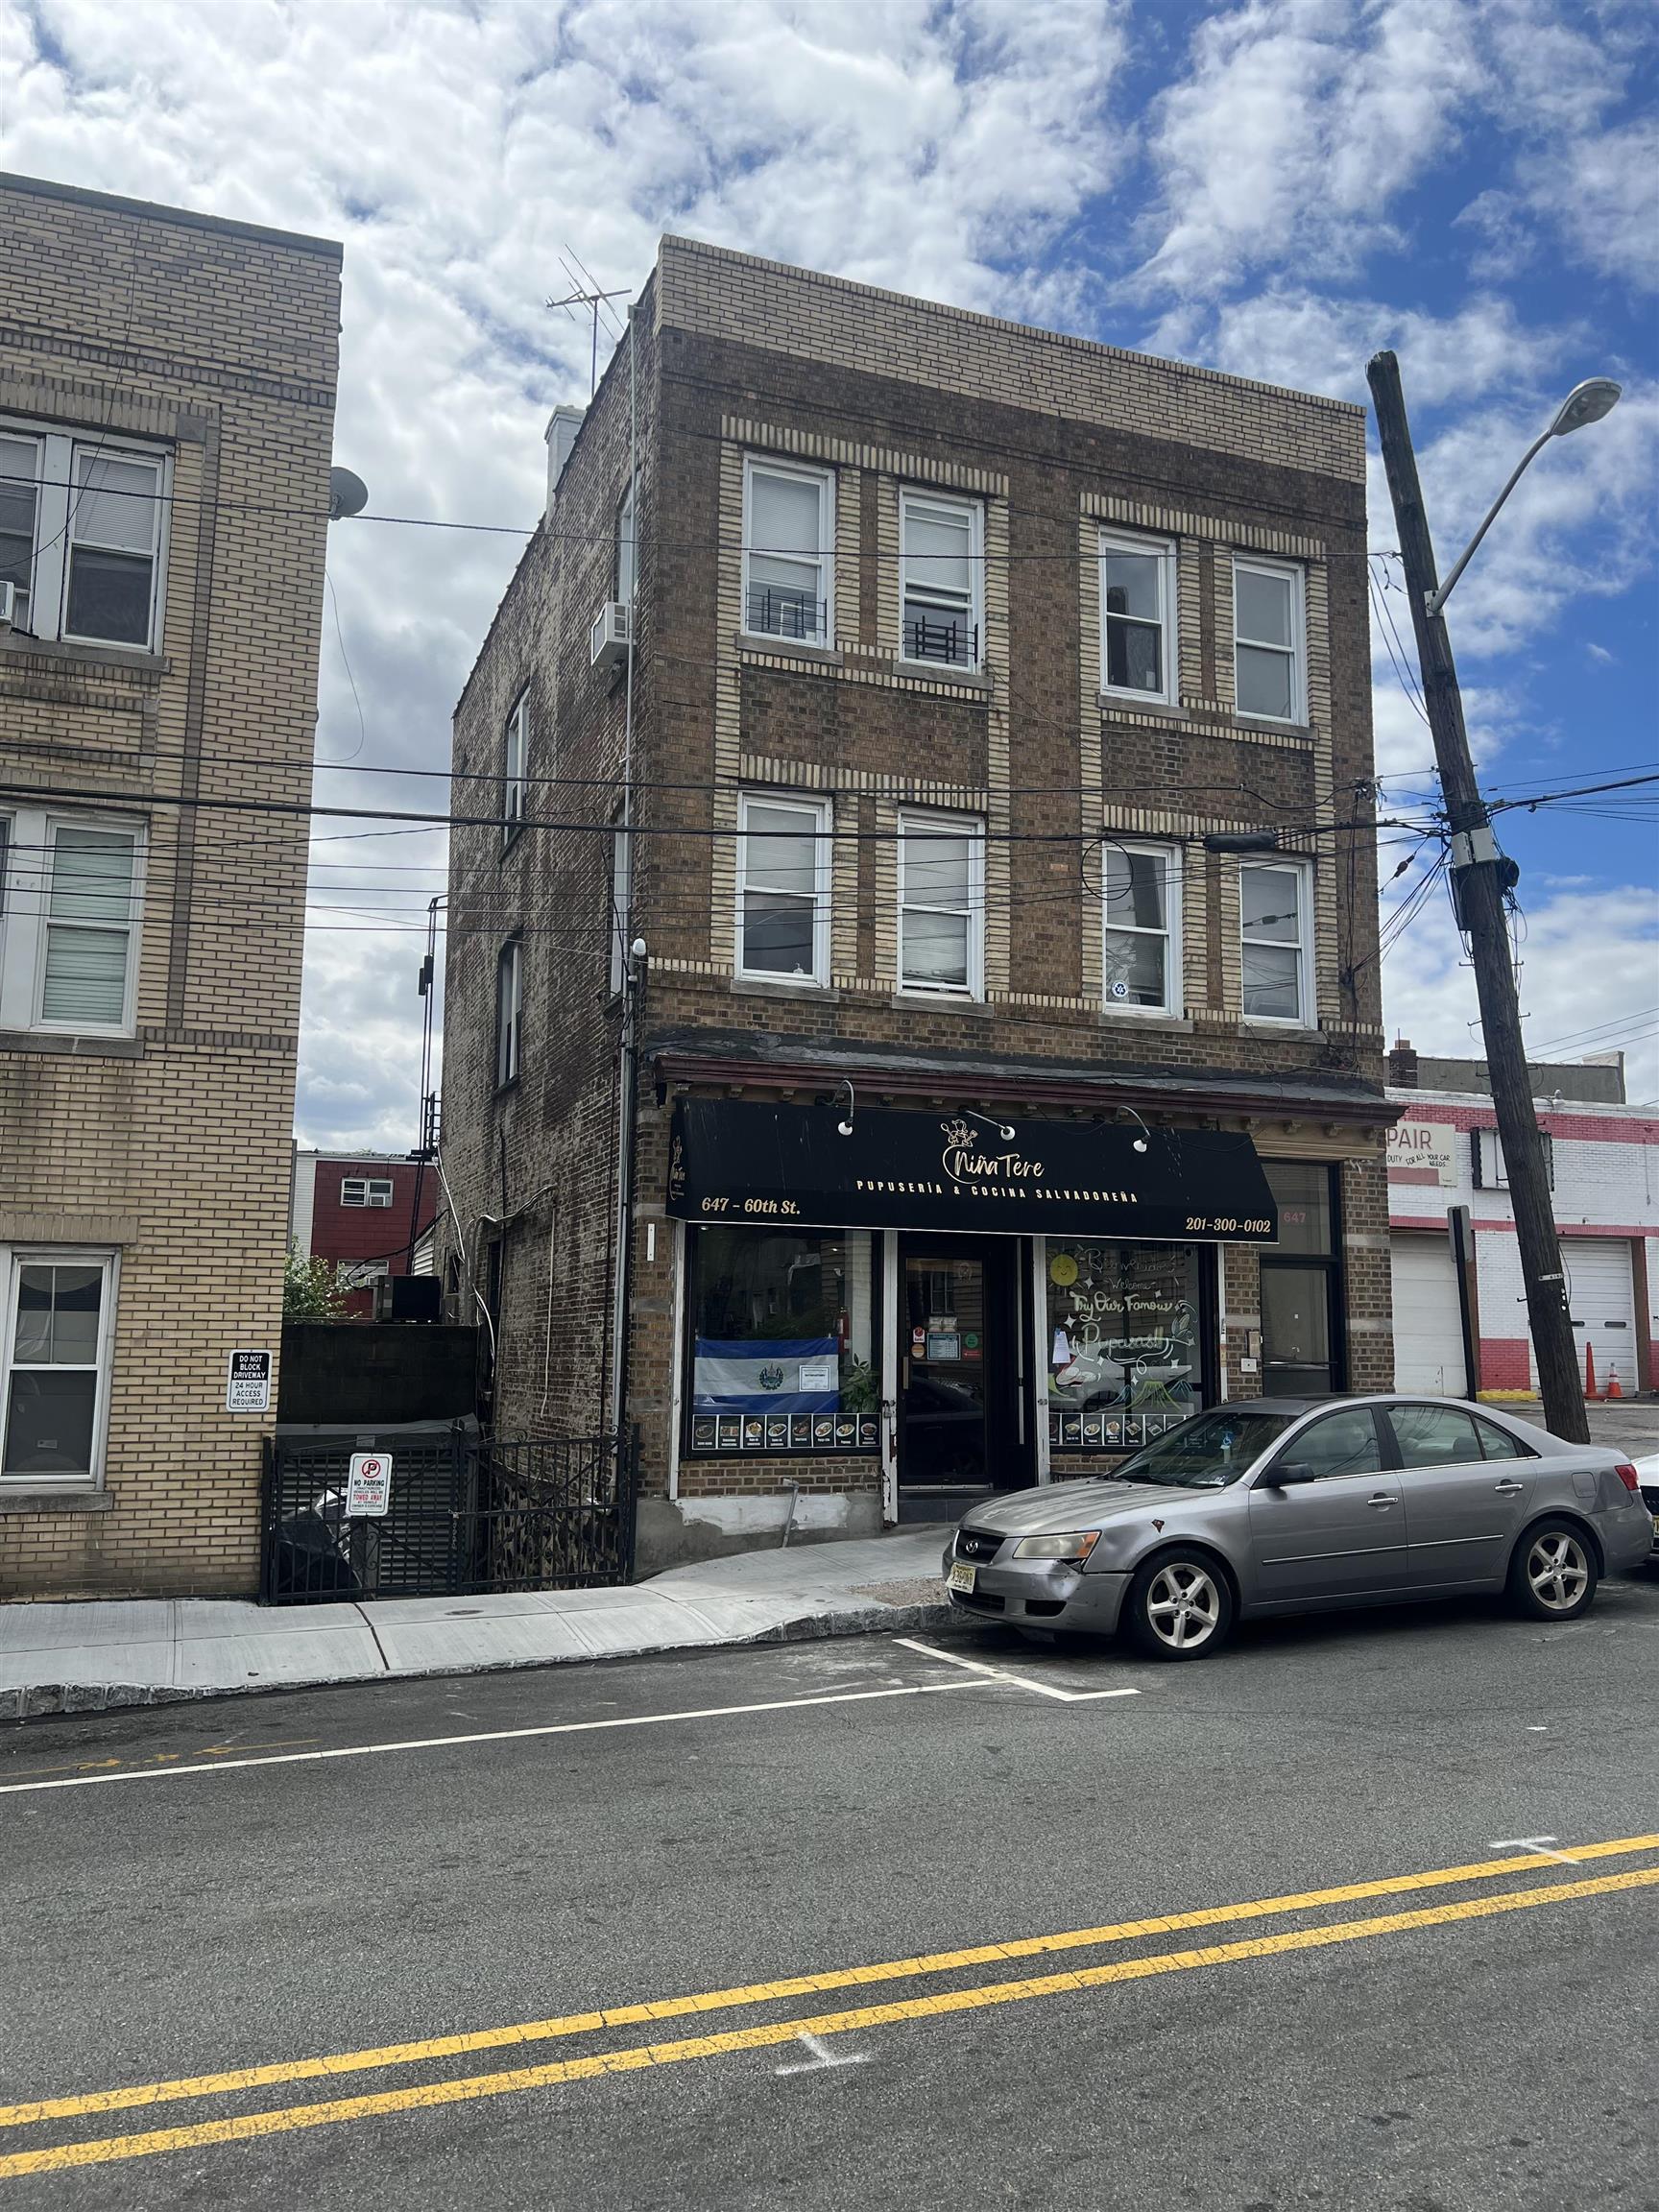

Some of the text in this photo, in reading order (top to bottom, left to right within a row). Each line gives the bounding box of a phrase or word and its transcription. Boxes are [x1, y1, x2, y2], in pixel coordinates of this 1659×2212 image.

[1387, 1127, 1431, 1150] PAIR
[954, 1150, 1046, 1178] Niña Tere
[1387, 1154, 1403, 1164] DUTY
[1416, 1152, 1426, 1162] ALL
[856, 1180, 1138, 1203] PUPUSERÍA & COCINA SALVADOREÑA
[701, 1197, 730, 1212] 647
[744, 1198, 778, 1214] 60th
[781, 1199, 801, 1214] St.
[1186, 1216, 1271, 1233] 201-300-0102
[1283, 1212, 1307, 1223] 647
[1069, 1290, 1173, 1323] Try Our Famous
[239, 1355, 263, 1363] DO NOT
[233, 1371, 267, 1380] DRIVEWAY
